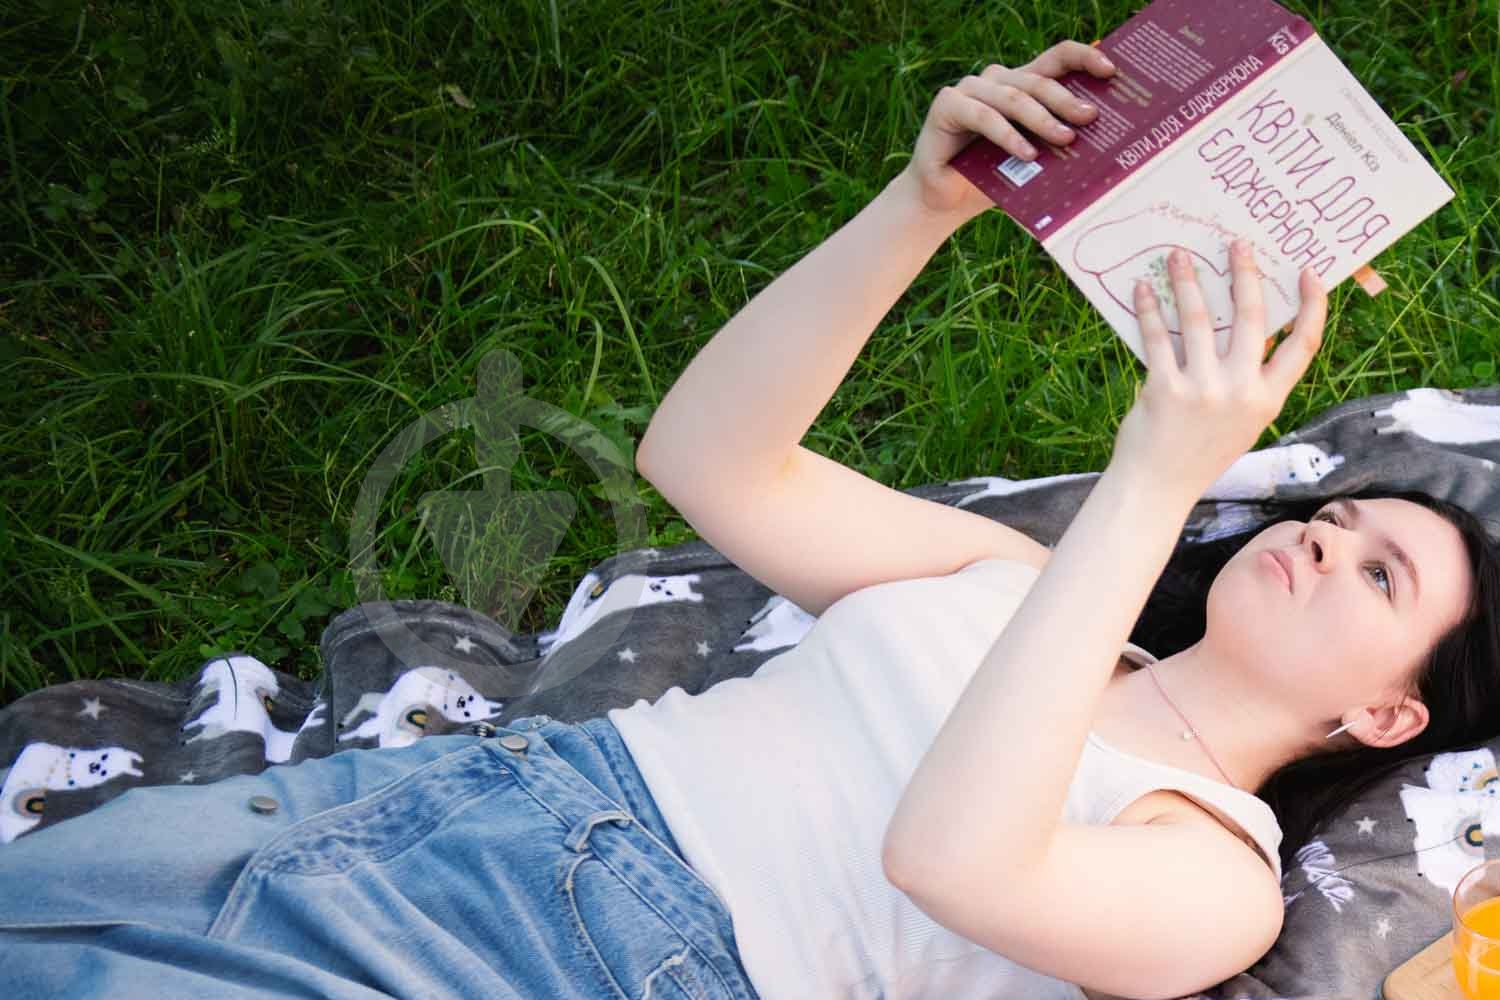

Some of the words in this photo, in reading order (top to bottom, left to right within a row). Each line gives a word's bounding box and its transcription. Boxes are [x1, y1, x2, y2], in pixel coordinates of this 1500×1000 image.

[1115, 135, 1156, 170] КВІТИ
[1151, 115, 1185, 148] ДЛЯ
[1238, 89, 1336, 189] КВІТИ
[1295, 176, 1391, 255] ДЛЯ
